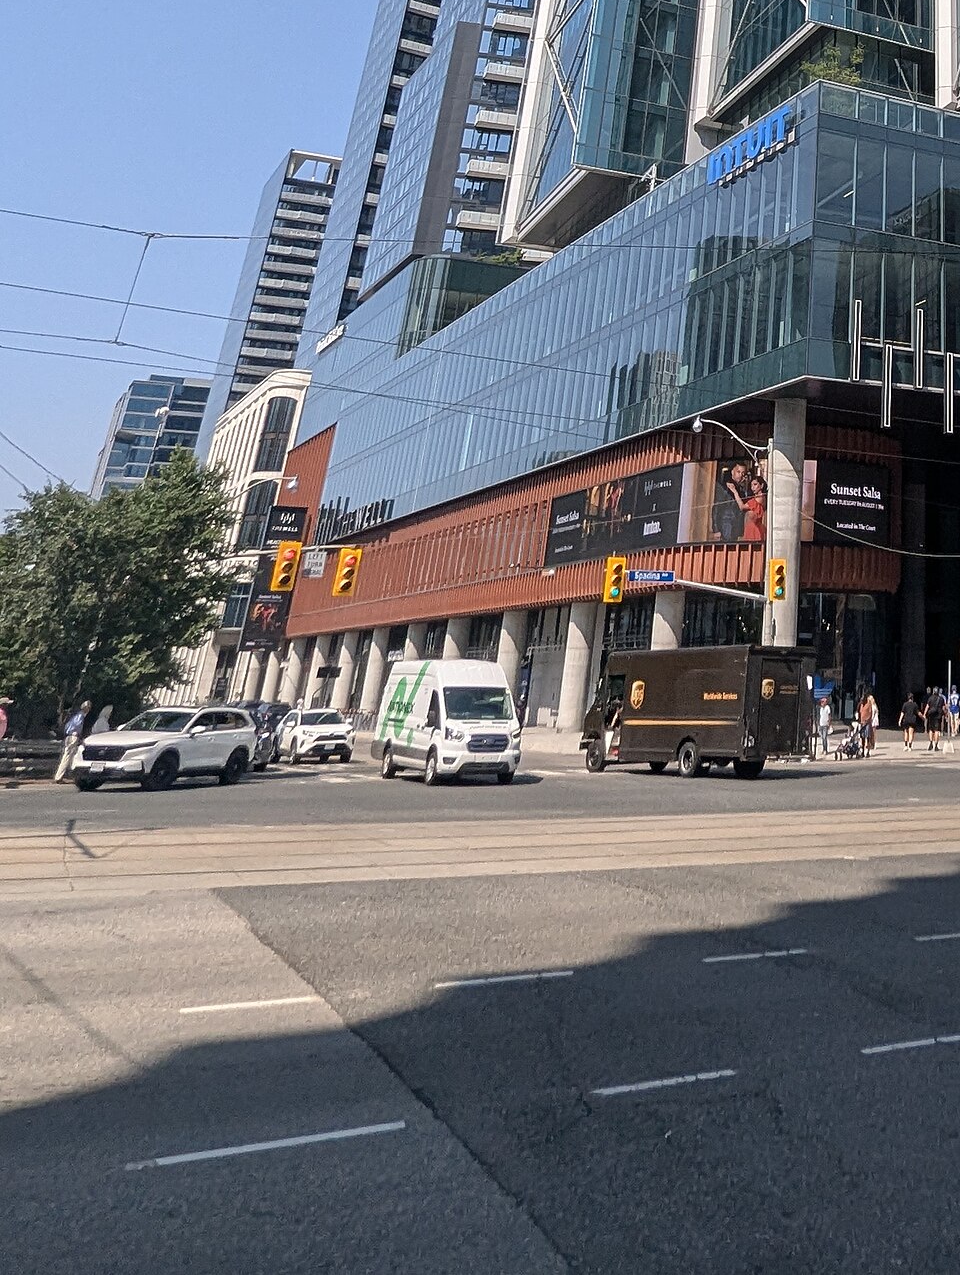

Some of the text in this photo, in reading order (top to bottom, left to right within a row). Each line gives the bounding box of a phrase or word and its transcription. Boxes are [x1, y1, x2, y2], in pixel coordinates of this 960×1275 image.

[830, 482, 881, 500] Sunset Salsa
[836, 522, 854, 530] Located
[634, 571, 661, 581] Spadina
